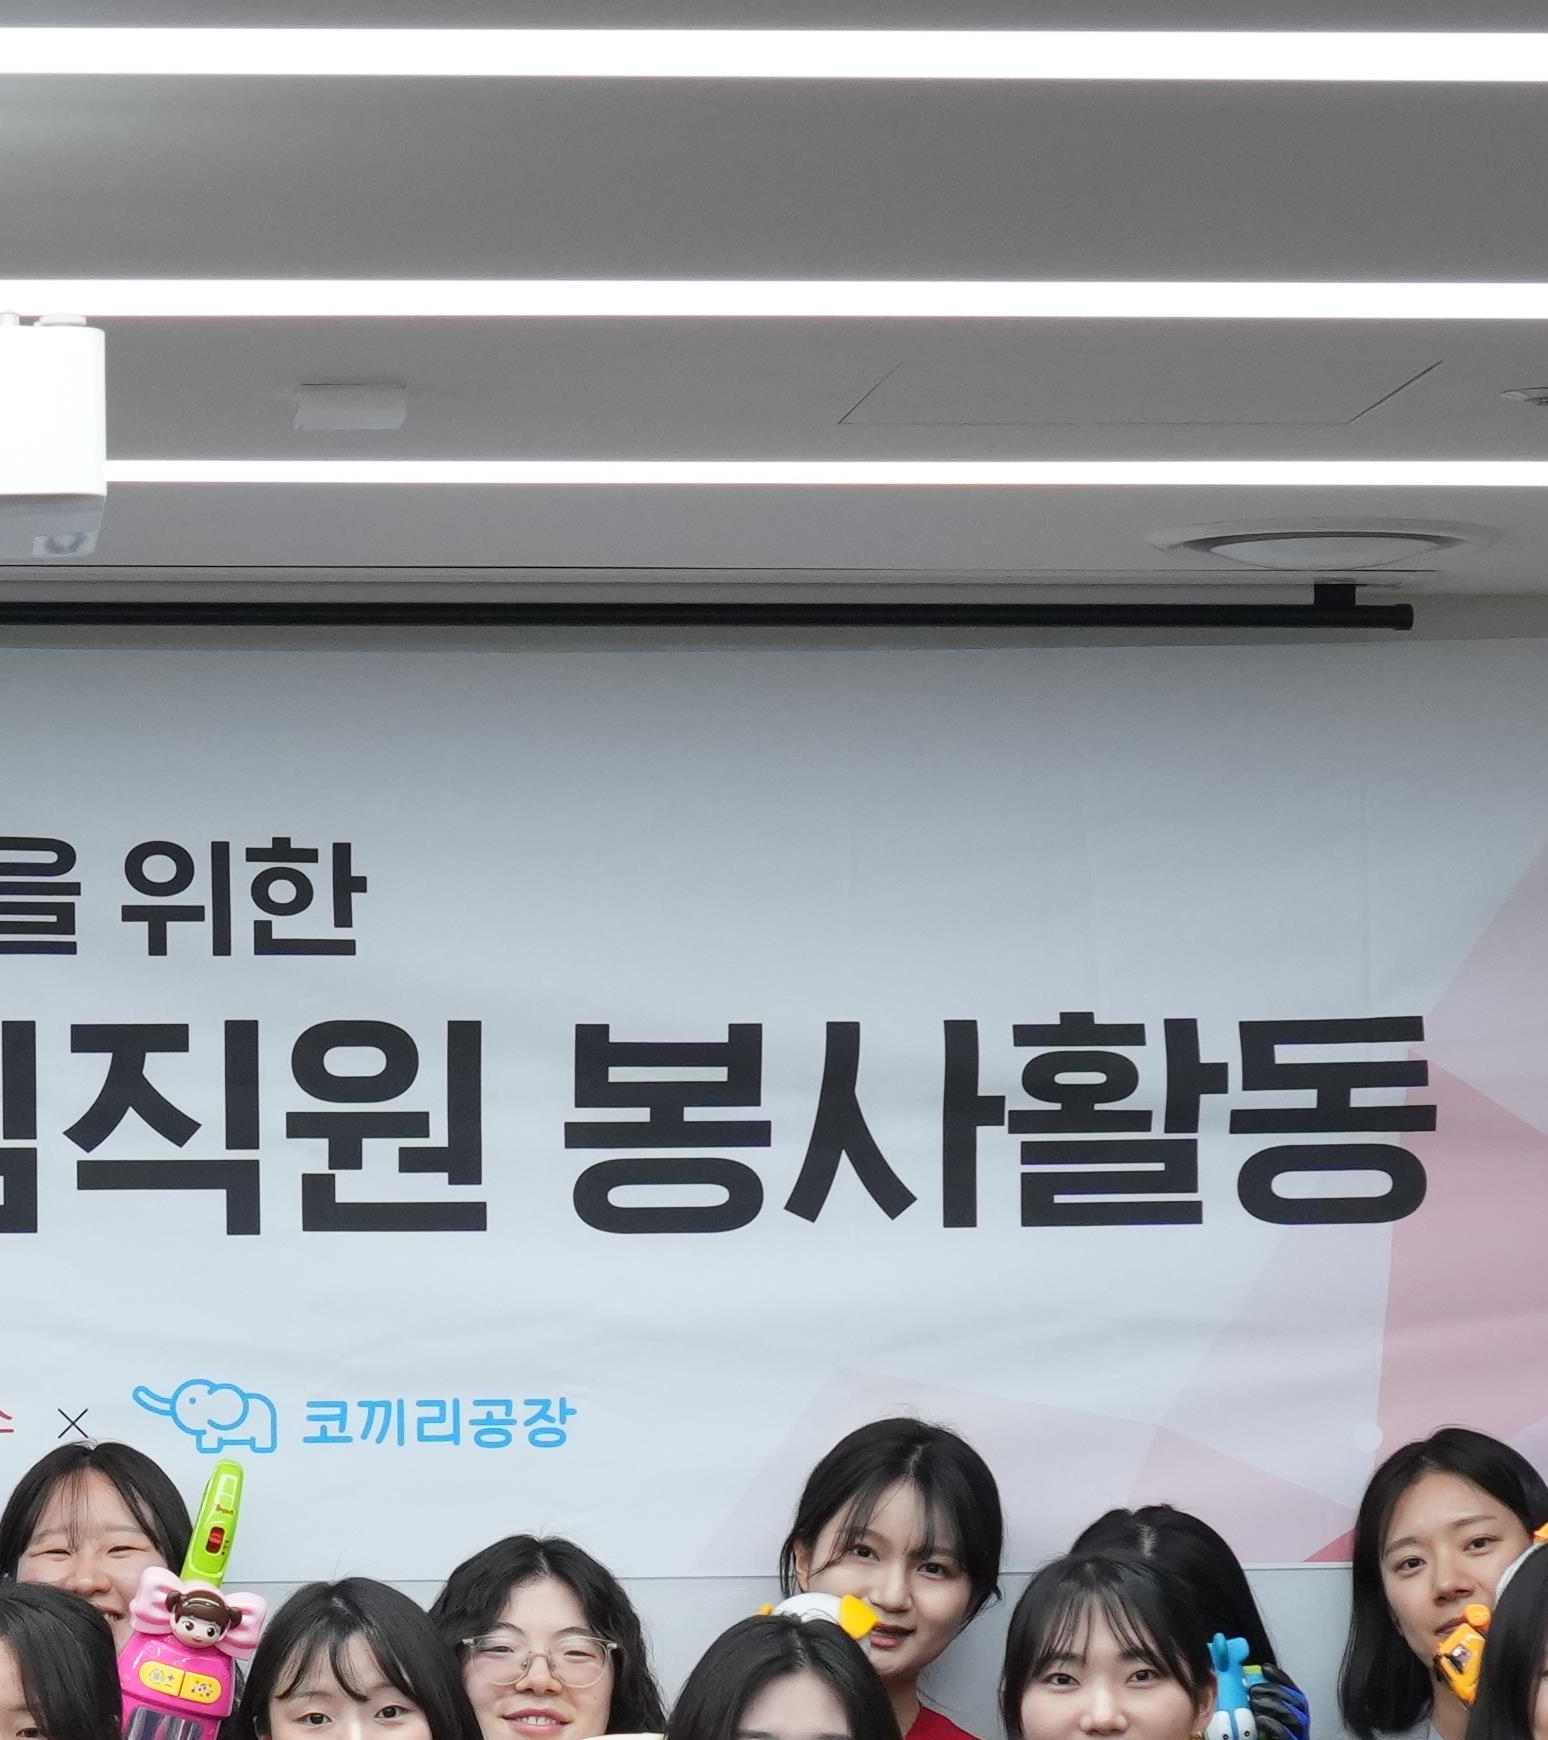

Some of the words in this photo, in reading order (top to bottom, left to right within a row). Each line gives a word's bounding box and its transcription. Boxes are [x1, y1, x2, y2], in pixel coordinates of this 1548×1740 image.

[121, 836, 368, 957] 위한
[564, 1011, 1438, 1235] 봉사활동
[302, 1397, 578, 1450] 코끼리공장
